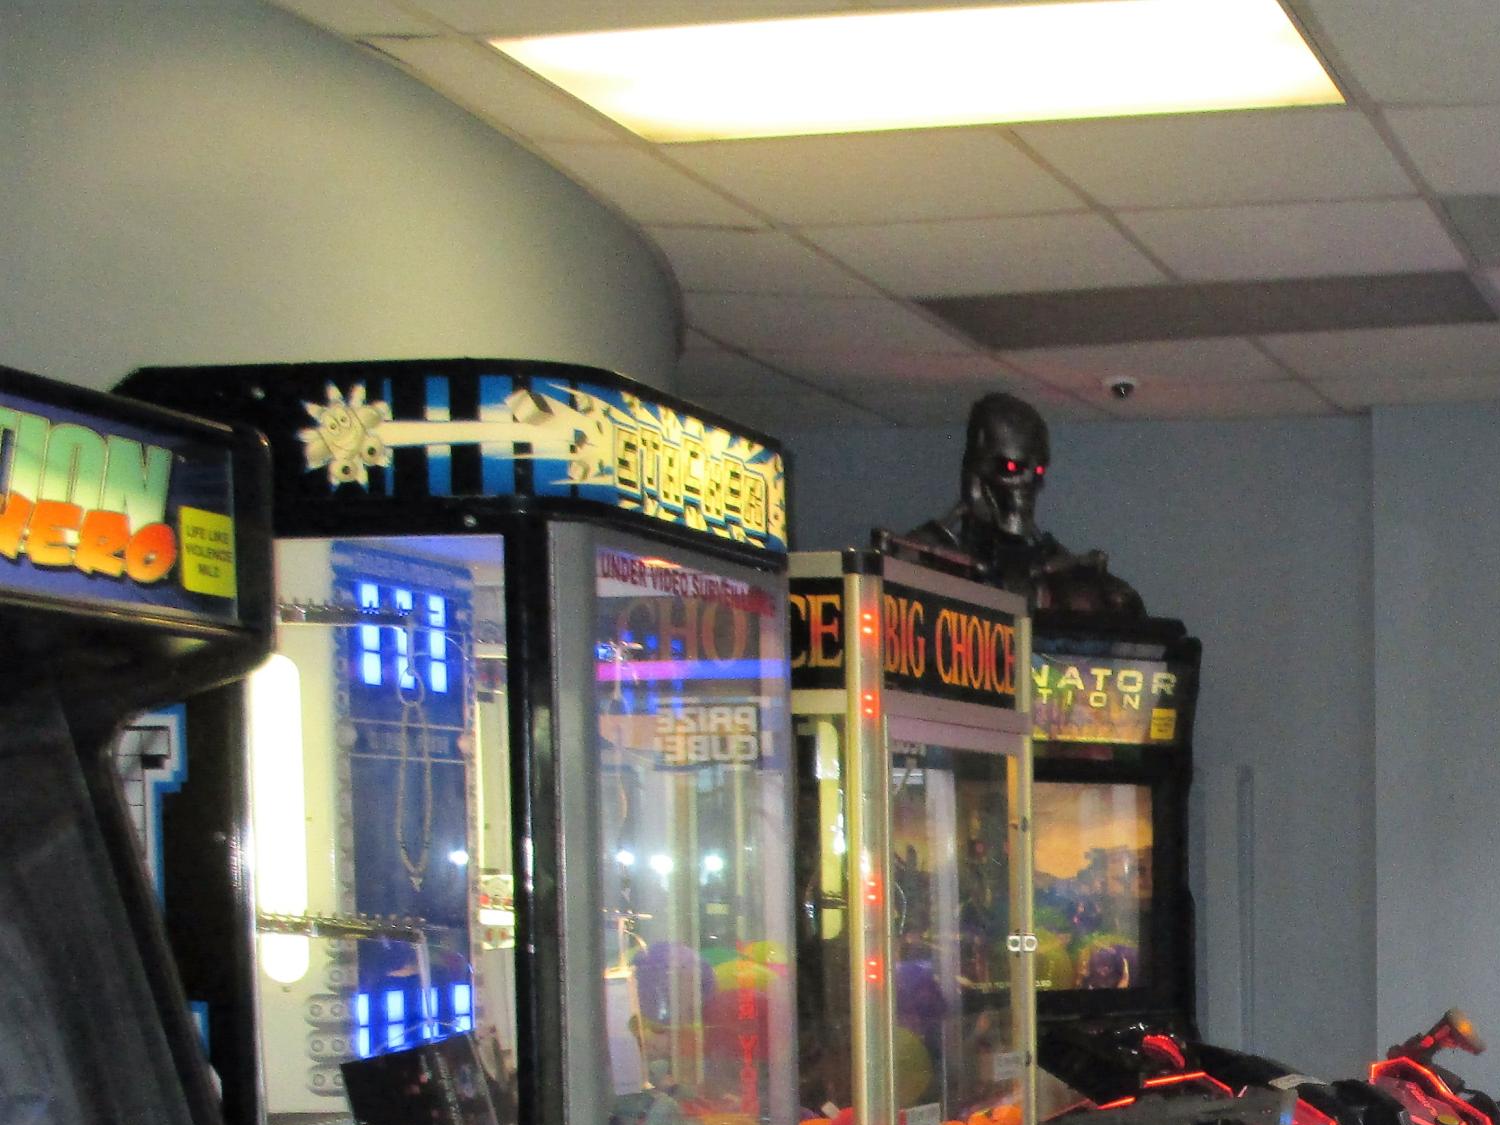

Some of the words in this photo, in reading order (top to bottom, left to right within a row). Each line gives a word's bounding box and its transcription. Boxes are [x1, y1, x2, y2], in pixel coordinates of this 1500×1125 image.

[615, 424, 766, 536] STACKER
[601, 553, 648, 588] UNDER
[652, 567, 689, 597] VIDEO
[884, 594, 926, 678] BIG
[935, 607, 1016, 696] CHOICE
